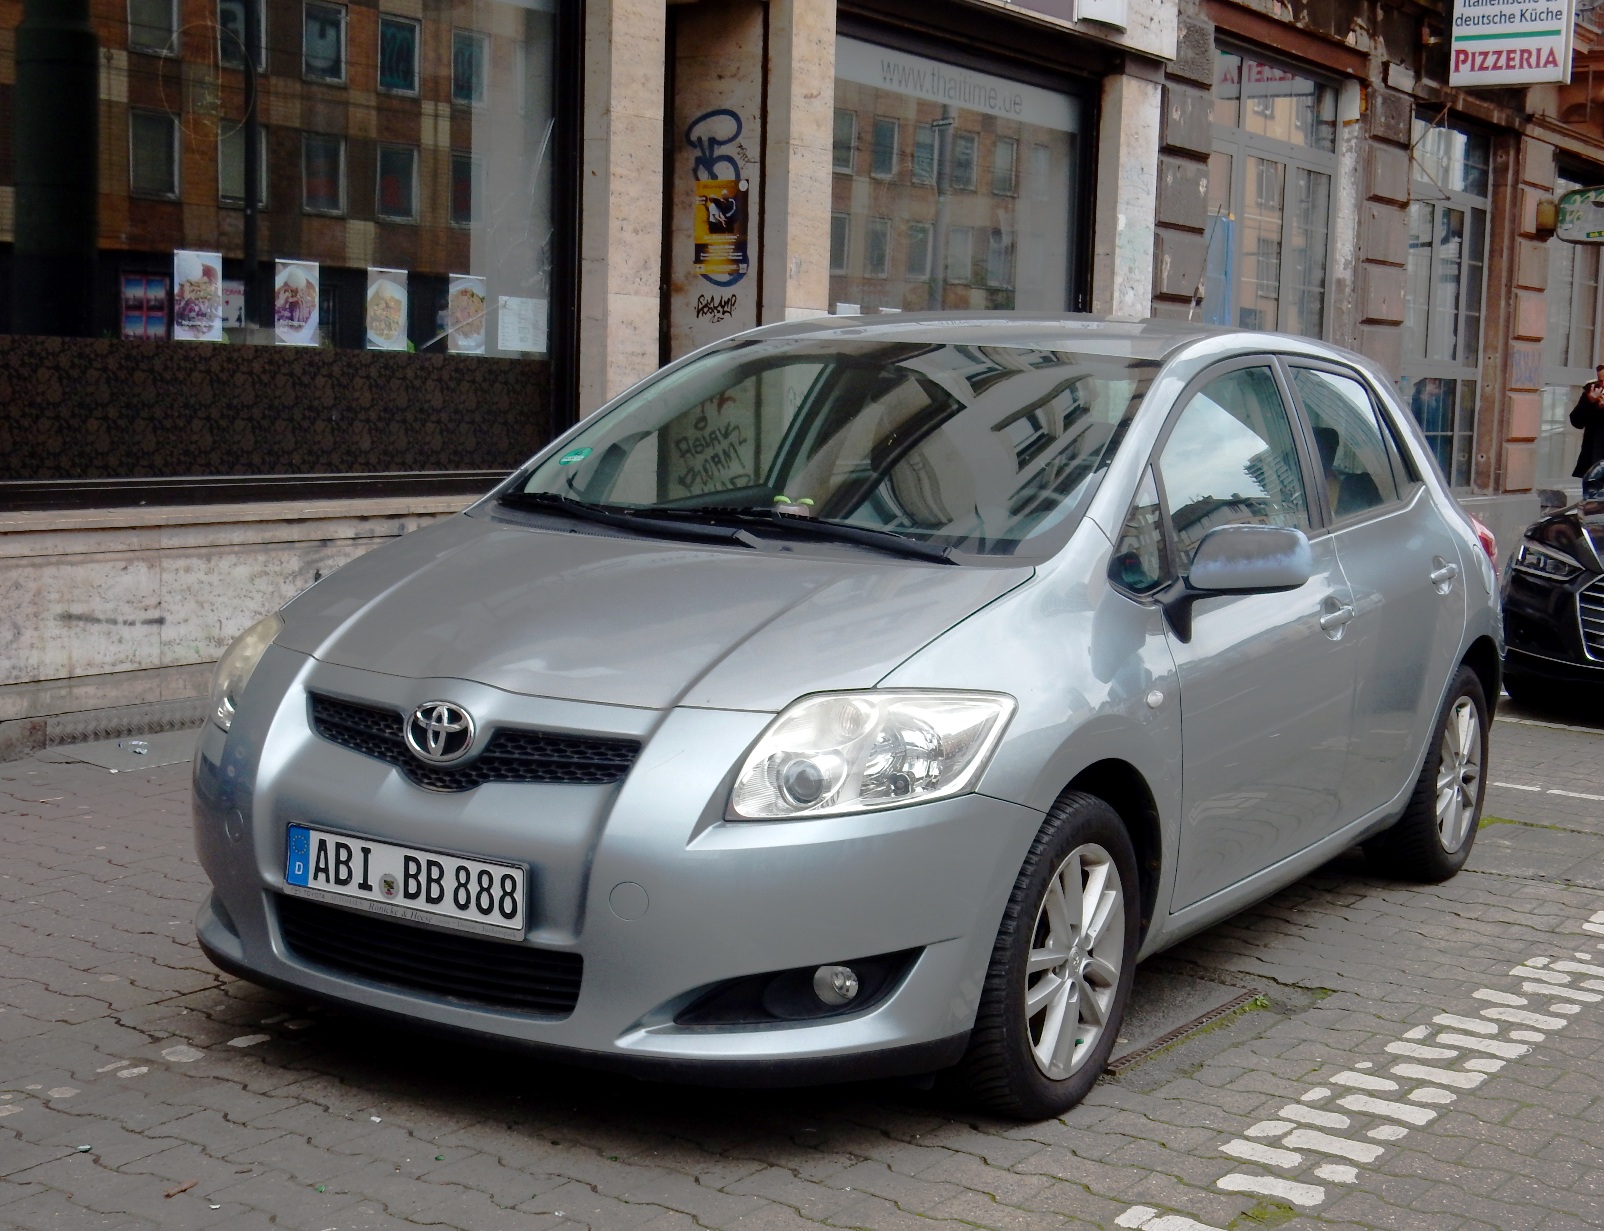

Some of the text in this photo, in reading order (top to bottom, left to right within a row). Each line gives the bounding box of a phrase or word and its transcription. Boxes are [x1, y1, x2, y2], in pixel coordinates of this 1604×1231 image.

[1455, 7, 1563, 27] deutsche Küche
[1453, 46, 1559, 73] PIZZERIA
[294, 861, 304, 875] D
[313, 838, 373, 892] ABI
[303, 889, 326, 900] TOYOTA
